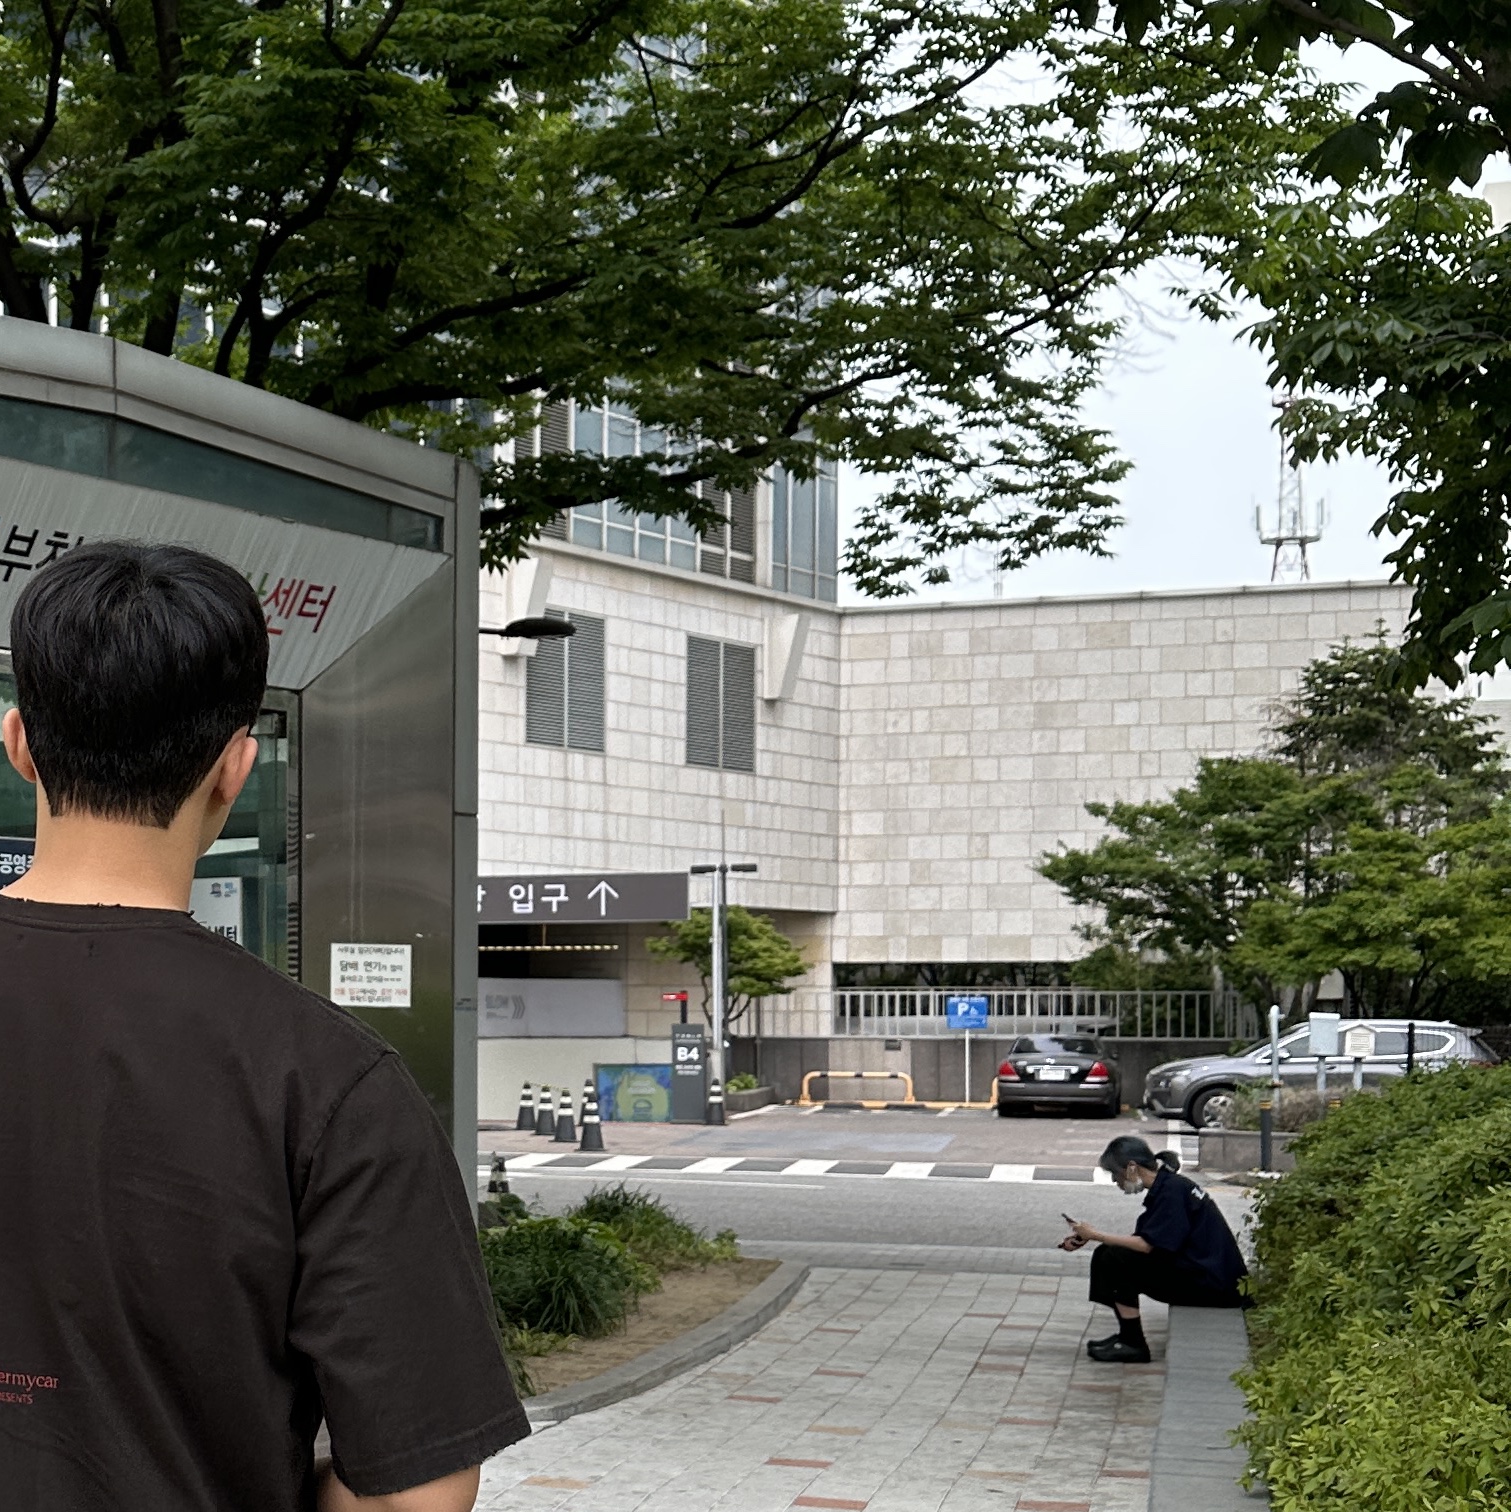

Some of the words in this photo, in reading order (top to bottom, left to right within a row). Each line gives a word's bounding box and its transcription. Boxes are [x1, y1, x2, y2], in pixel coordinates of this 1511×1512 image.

[509, 883, 569, 914] 입구
[958, 1002, 969, 1017] P
[676, 1046, 699, 1062] B4
